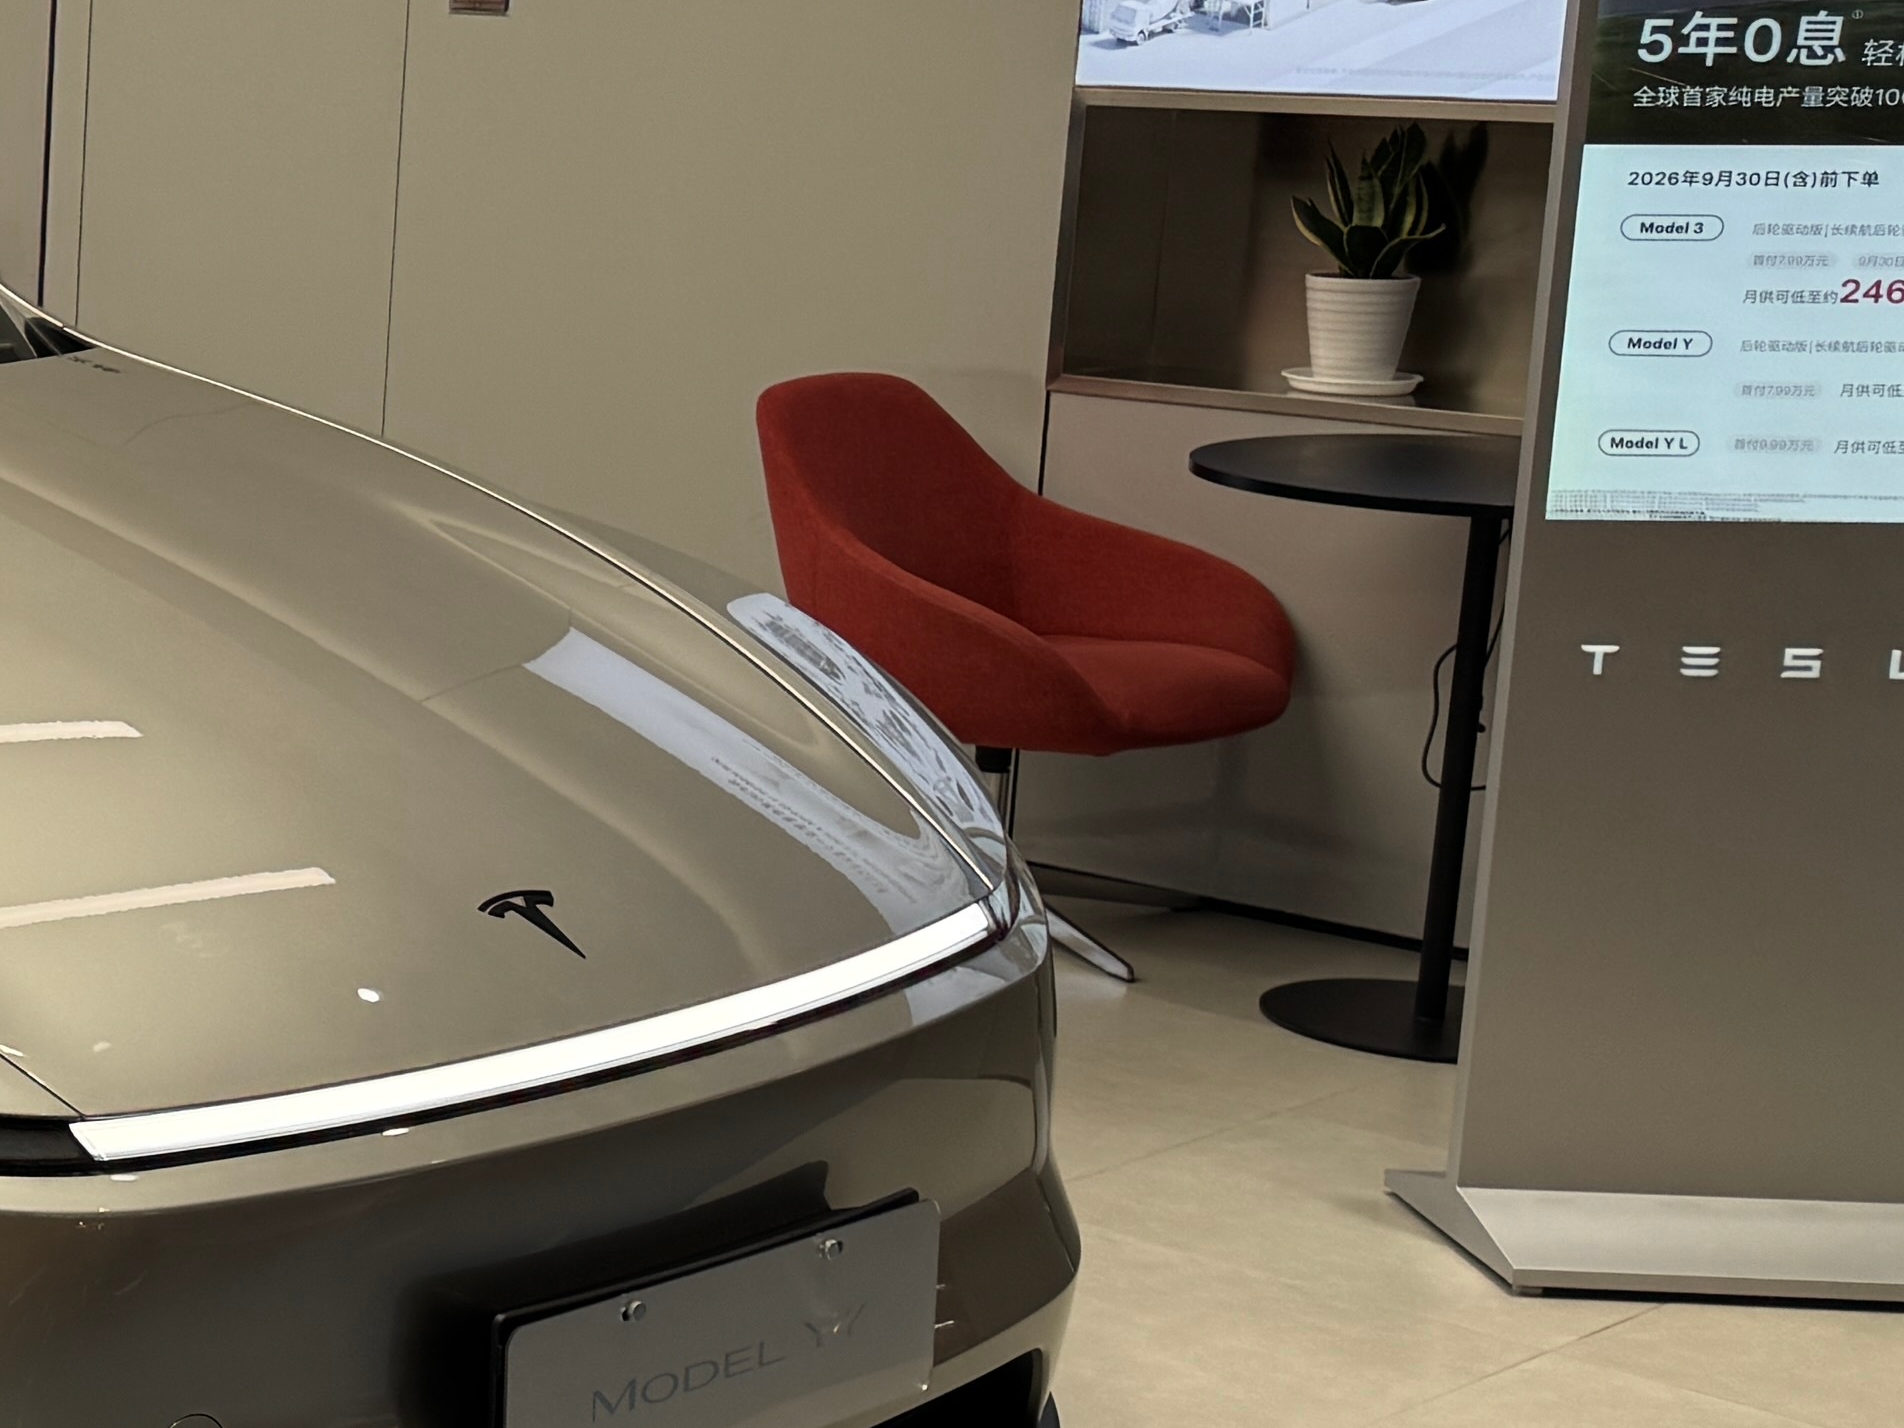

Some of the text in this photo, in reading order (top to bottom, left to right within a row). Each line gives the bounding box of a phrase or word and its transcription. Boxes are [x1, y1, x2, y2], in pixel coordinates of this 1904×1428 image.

[1637, 10, 1846, 67] 5年0息
[1633, 85, 1904, 108] 全球首家纯电产量突破10
[1627, 170, 1880, 189] 2026年9月30日(含)前下单
[1640, 221, 1704, 235] Model 3
[1627, 337, 1693, 351] Model Y
[1610, 437, 1689, 450] Model Y L
[590, 1340, 786, 1424] MODEL
